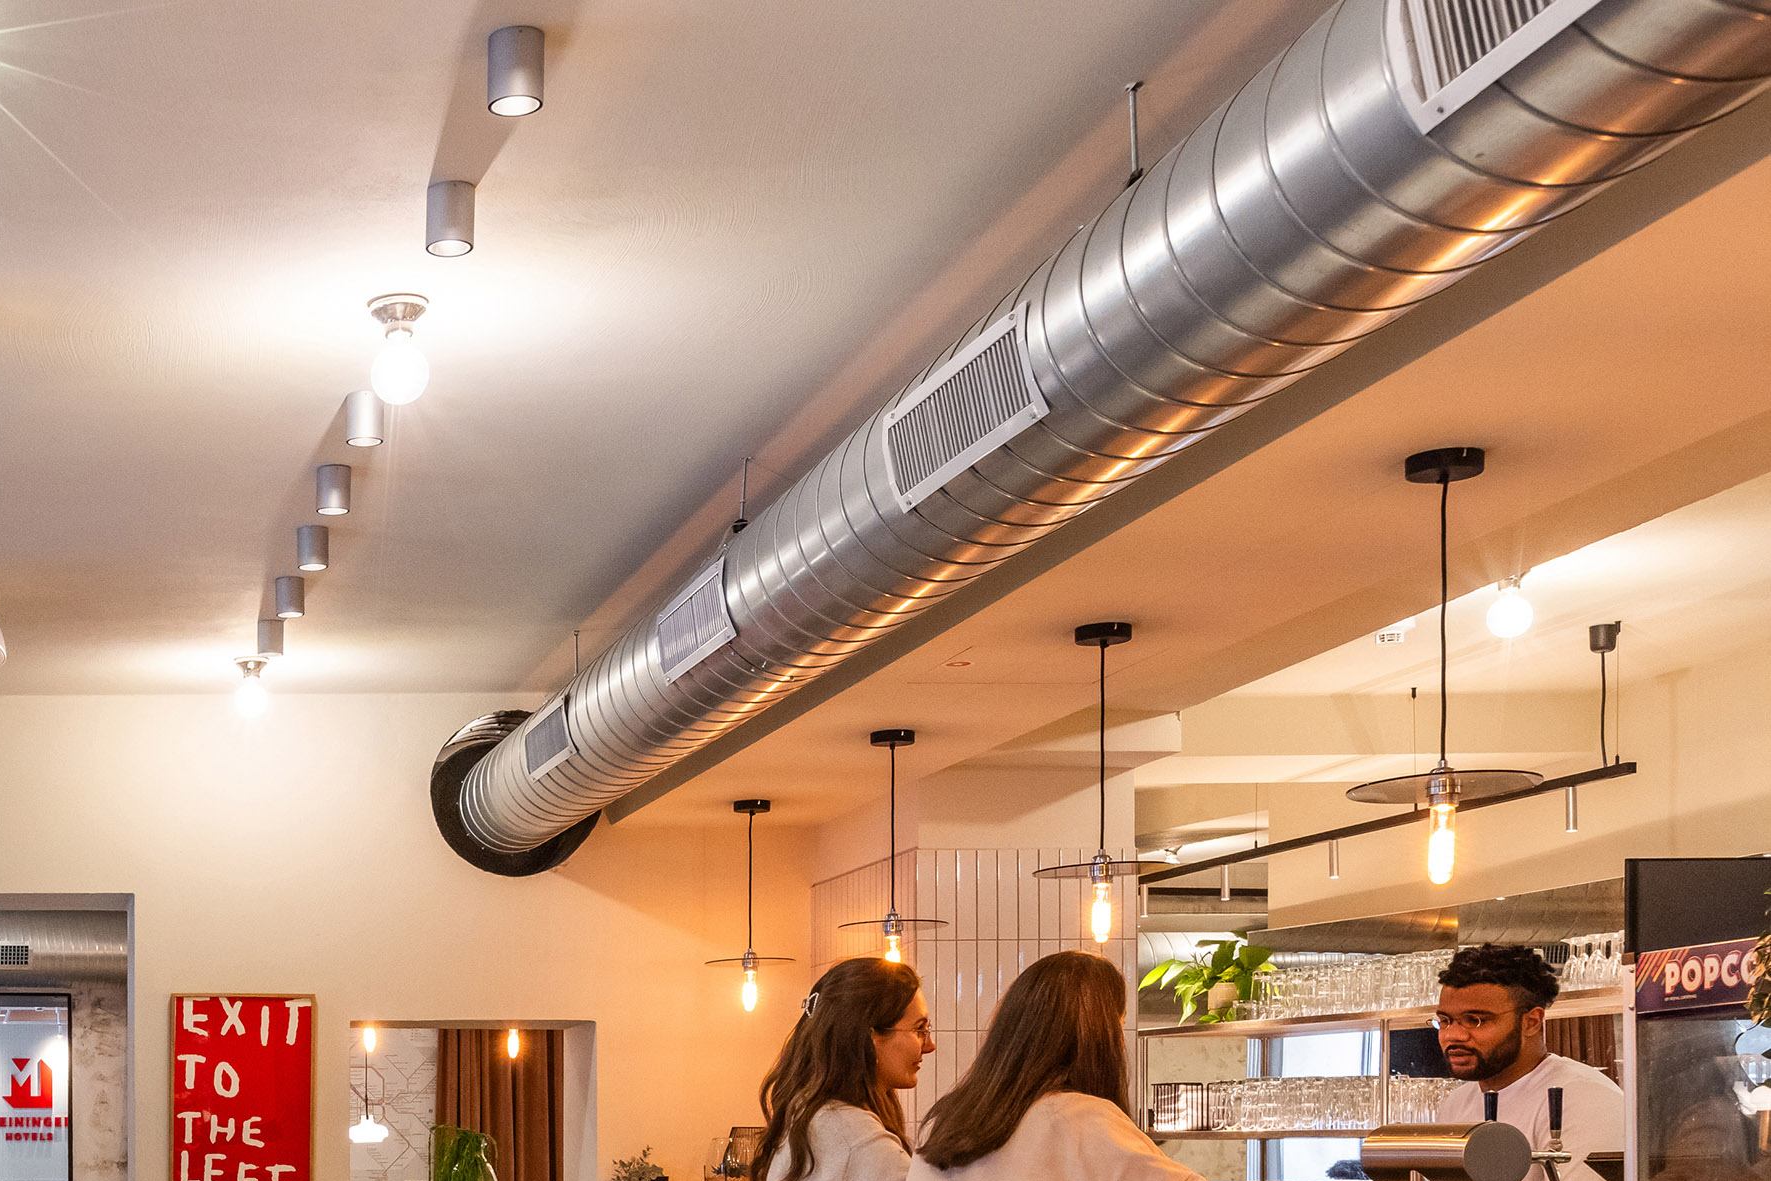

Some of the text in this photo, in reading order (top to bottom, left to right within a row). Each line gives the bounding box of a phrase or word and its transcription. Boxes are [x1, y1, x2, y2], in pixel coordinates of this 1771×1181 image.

[183, 997, 312, 1047] EXIT
[177, 1054, 240, 1099] TO
[5, 1132, 54, 1142] HOTELS
[177, 1111, 266, 1148] THE
